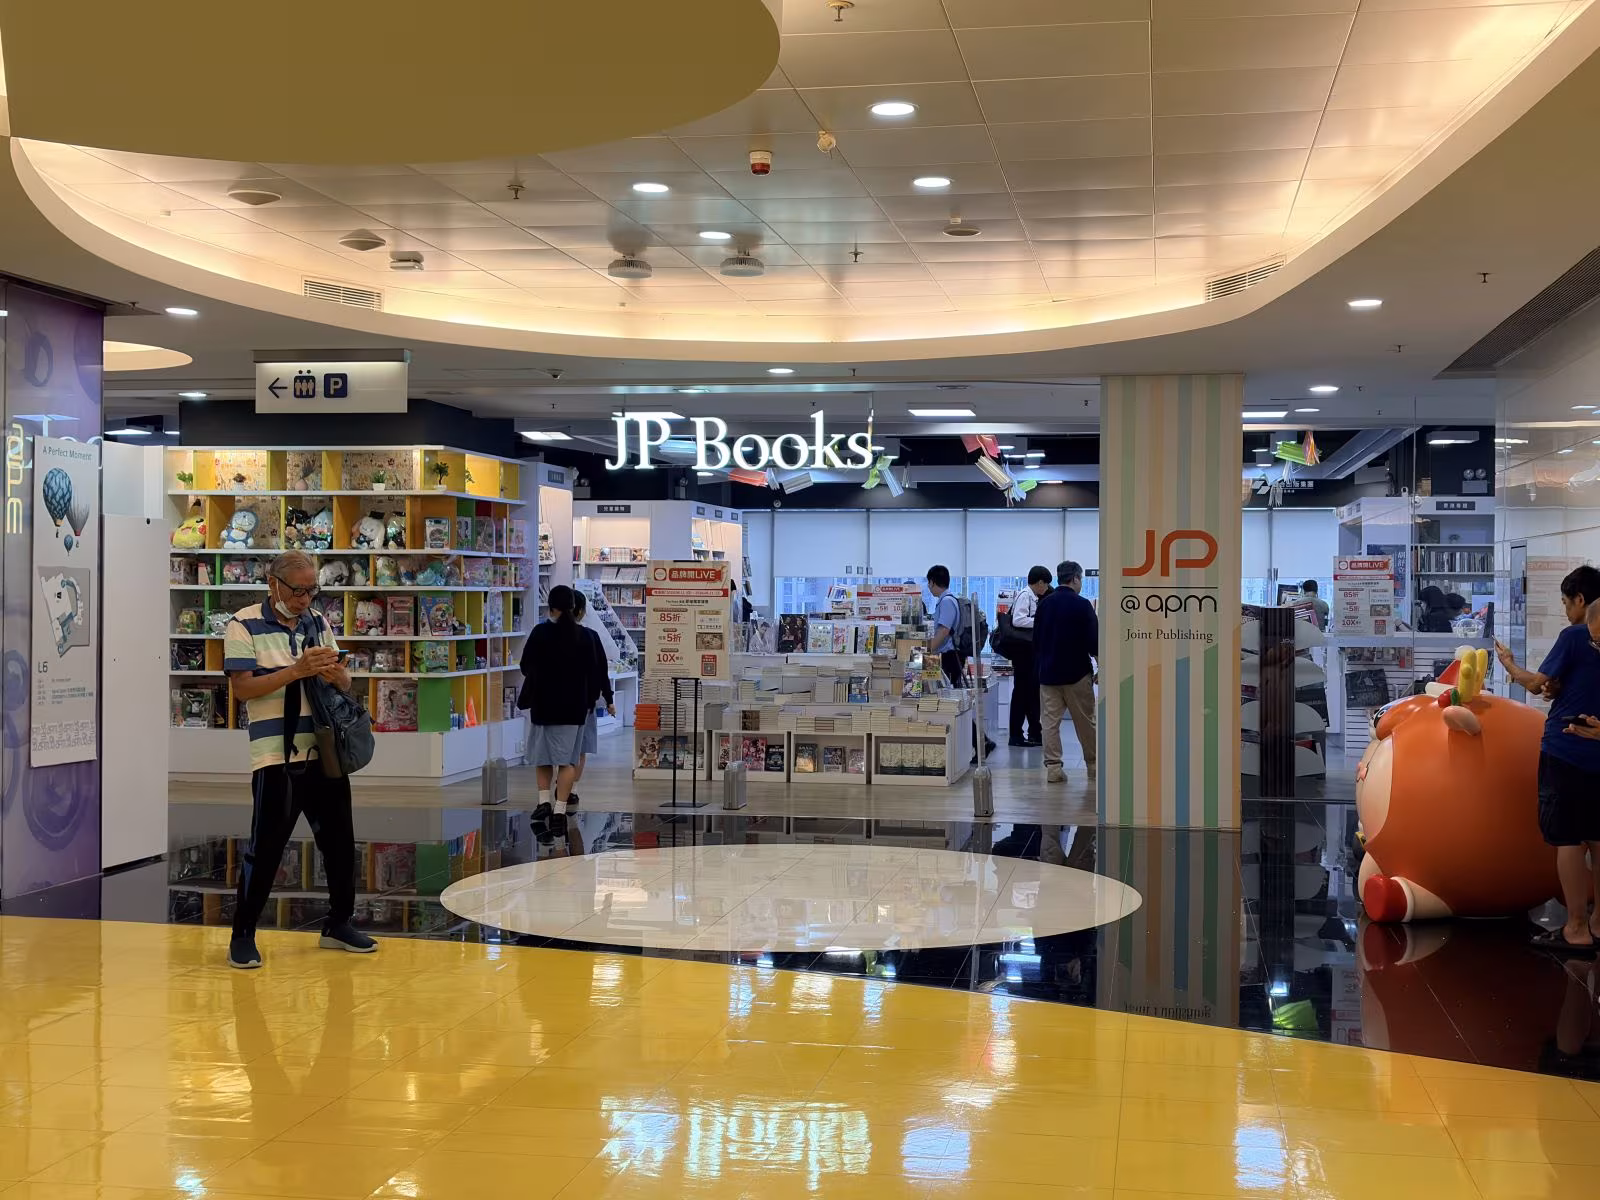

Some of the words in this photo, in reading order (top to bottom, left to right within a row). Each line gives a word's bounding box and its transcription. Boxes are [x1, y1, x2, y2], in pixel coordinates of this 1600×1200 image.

[605, 414, 671, 471] JP
[690, 409, 873, 471] Books
[42, 445, 48, 454] A
[48, 446, 68, 457] Perfect
[69, 449, 92, 461] Moment
[1121, 529, 1219, 577] JP
[1120, 594, 1140, 614] @
[1145, 594, 1218, 619] apm
[659, 613, 681, 622] 85折
[1125, 628, 1153, 642] Joint
[1156, 628, 1214, 644] Publishing
[37, 660, 49, 674] L6
